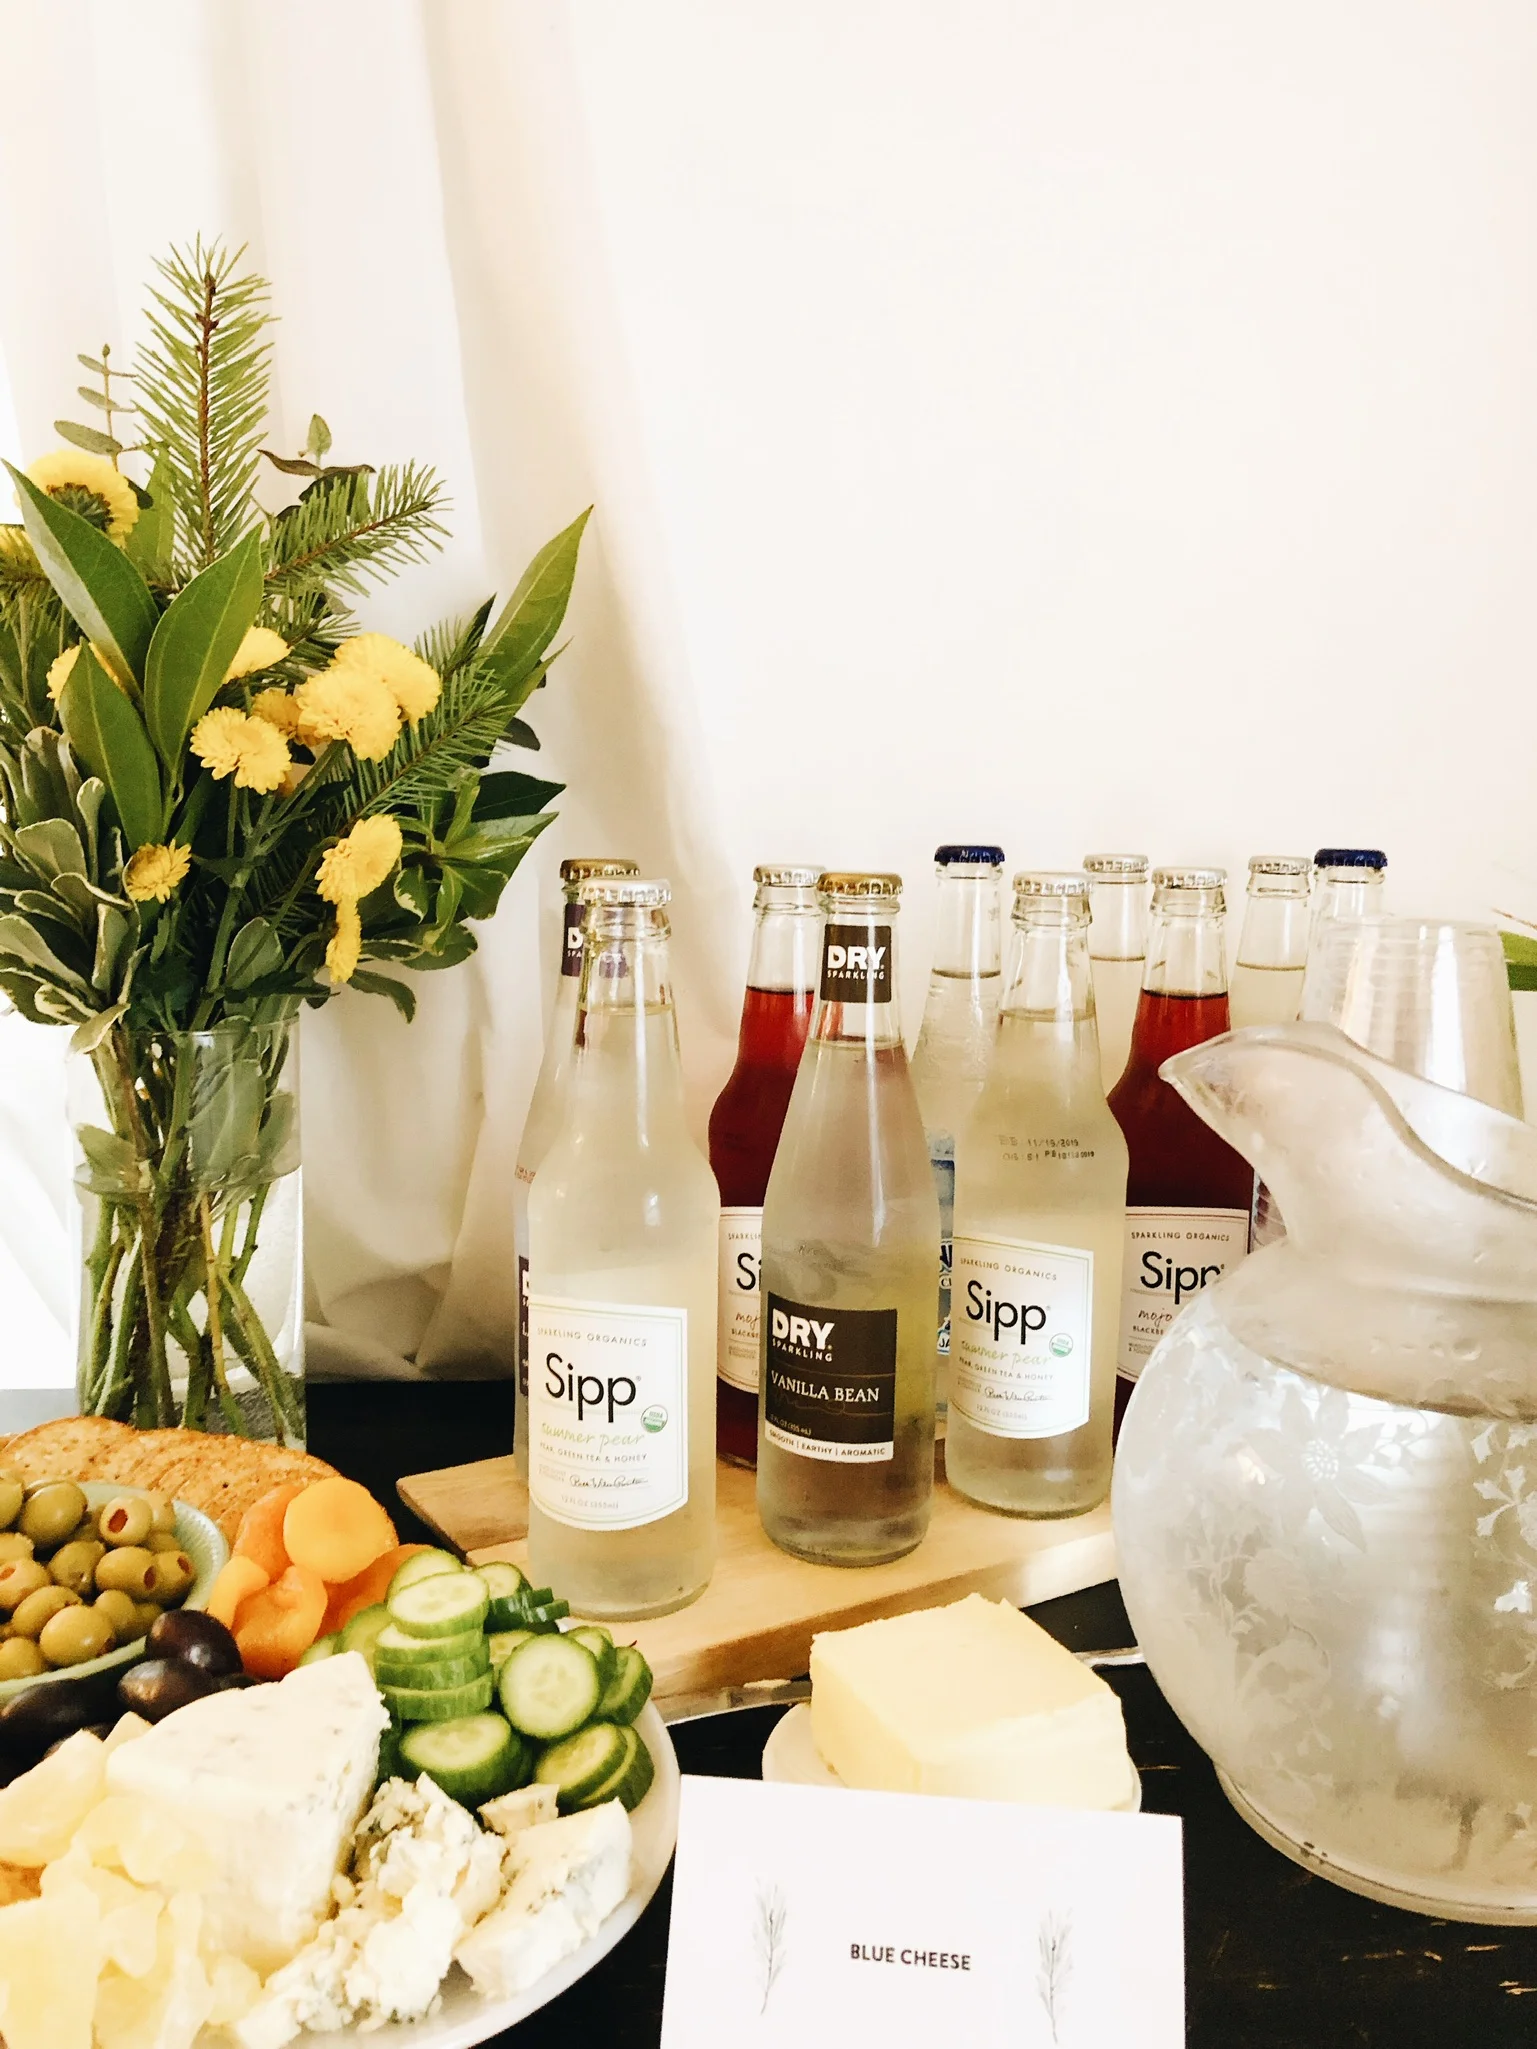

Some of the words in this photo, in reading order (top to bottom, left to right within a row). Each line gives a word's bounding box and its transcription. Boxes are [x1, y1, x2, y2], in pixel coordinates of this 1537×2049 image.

[828, 945, 886, 970] DRY
[1131, 1232, 1181, 1240] SPARKLING
[1186, 1232, 1230, 1242] ORGANICS
[960, 1258, 1000, 1270] SPARKLING
[1004, 1264, 1057, 1281] ORGANICS
[966, 1280, 1046, 1345] Sipp
[537, 1328, 581, 1340] SPARKLING
[586, 1333, 648, 1347] ORGANICS
[772, 1308, 835, 1350] DRY
[772, 1338, 833, 1362] SPARKLING
[1012, 1352, 1052, 1370] pear
[771, 1370, 830, 1400] VANILLA
[834, 1387, 880, 1402] BEAN
[1000, 1370, 1013, 1378] TEA
[546, 1352, 636, 1423] Sipp
[542, 1422, 595, 1444] summer
[599, 1433, 645, 1453] pear
[802, 1442, 833, 1455] EARTHY
[840, 1447, 886, 1456] AROMATIC
[558, 1447, 583, 1460] GREEN
[586, 1454, 600, 1462] TEA
[614, 1454, 648, 1462] HONEY
[850, 1944, 895, 1963] BLUE
[900, 1949, 970, 1971] CHEESE
